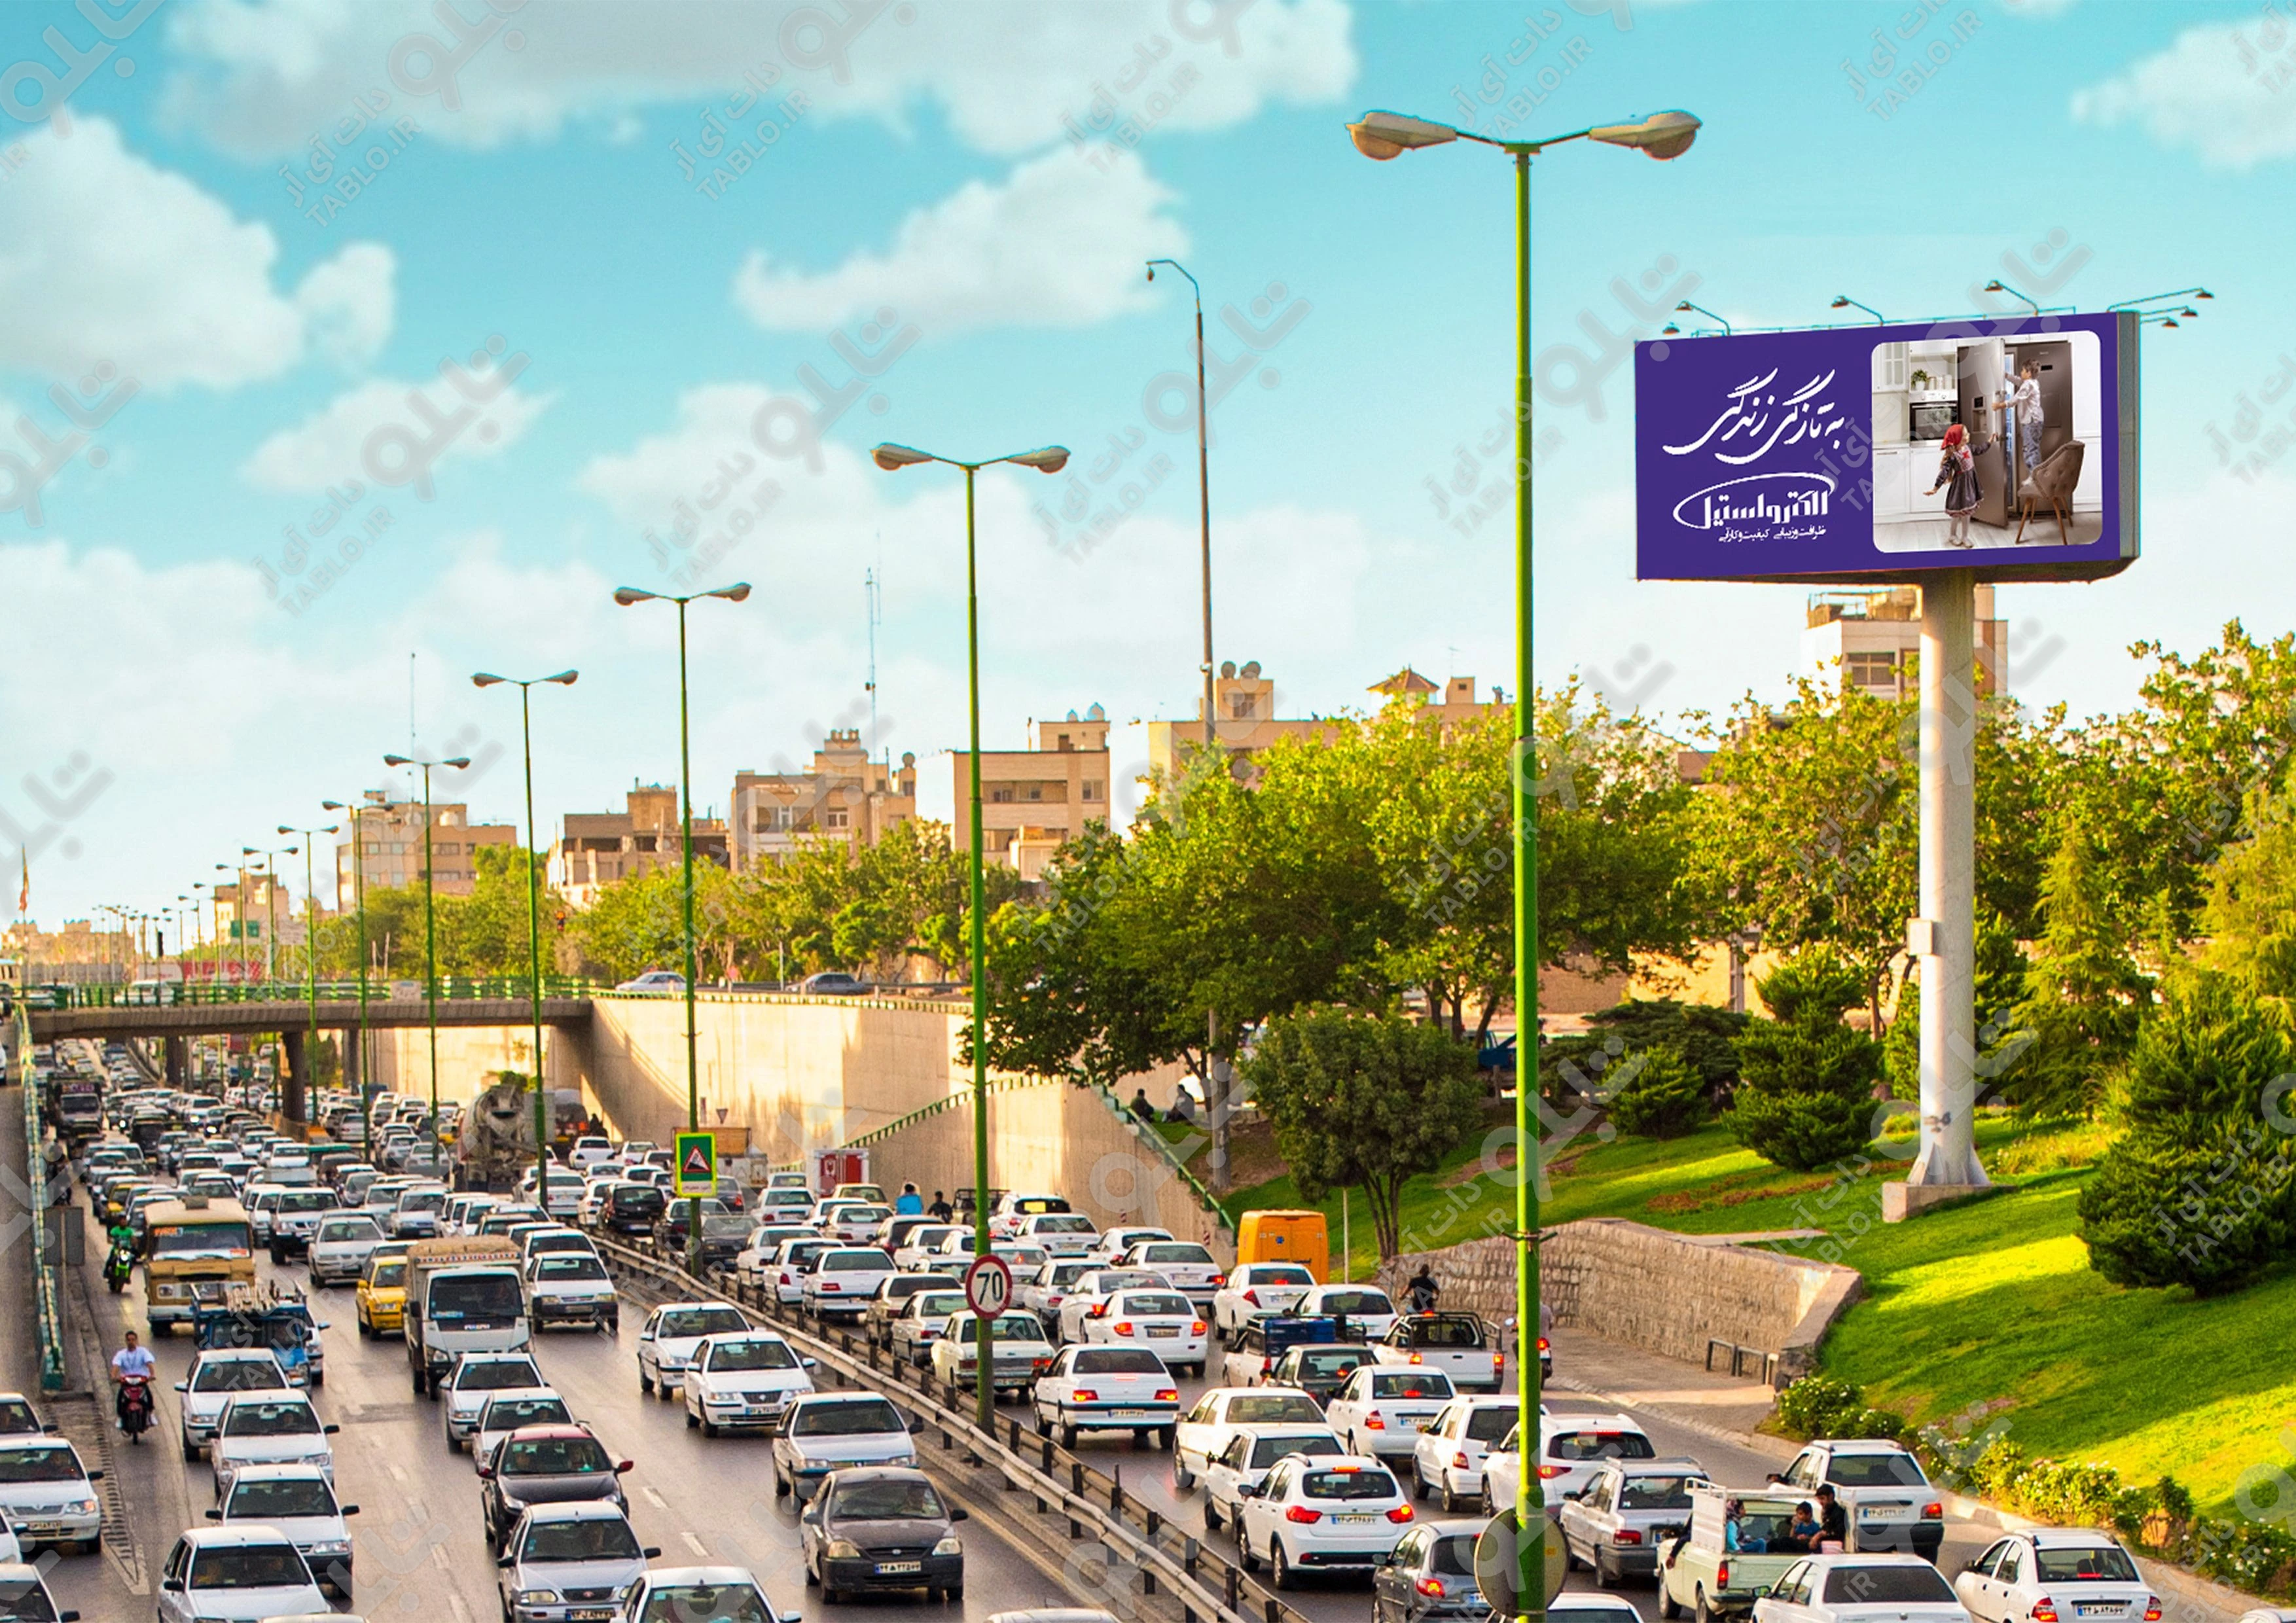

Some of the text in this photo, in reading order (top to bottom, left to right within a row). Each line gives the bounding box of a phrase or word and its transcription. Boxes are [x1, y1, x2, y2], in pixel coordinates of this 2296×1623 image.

[1662, 367, 1844, 465] به تازگی زندگی
[977, 1271, 1003, 1305] 70
